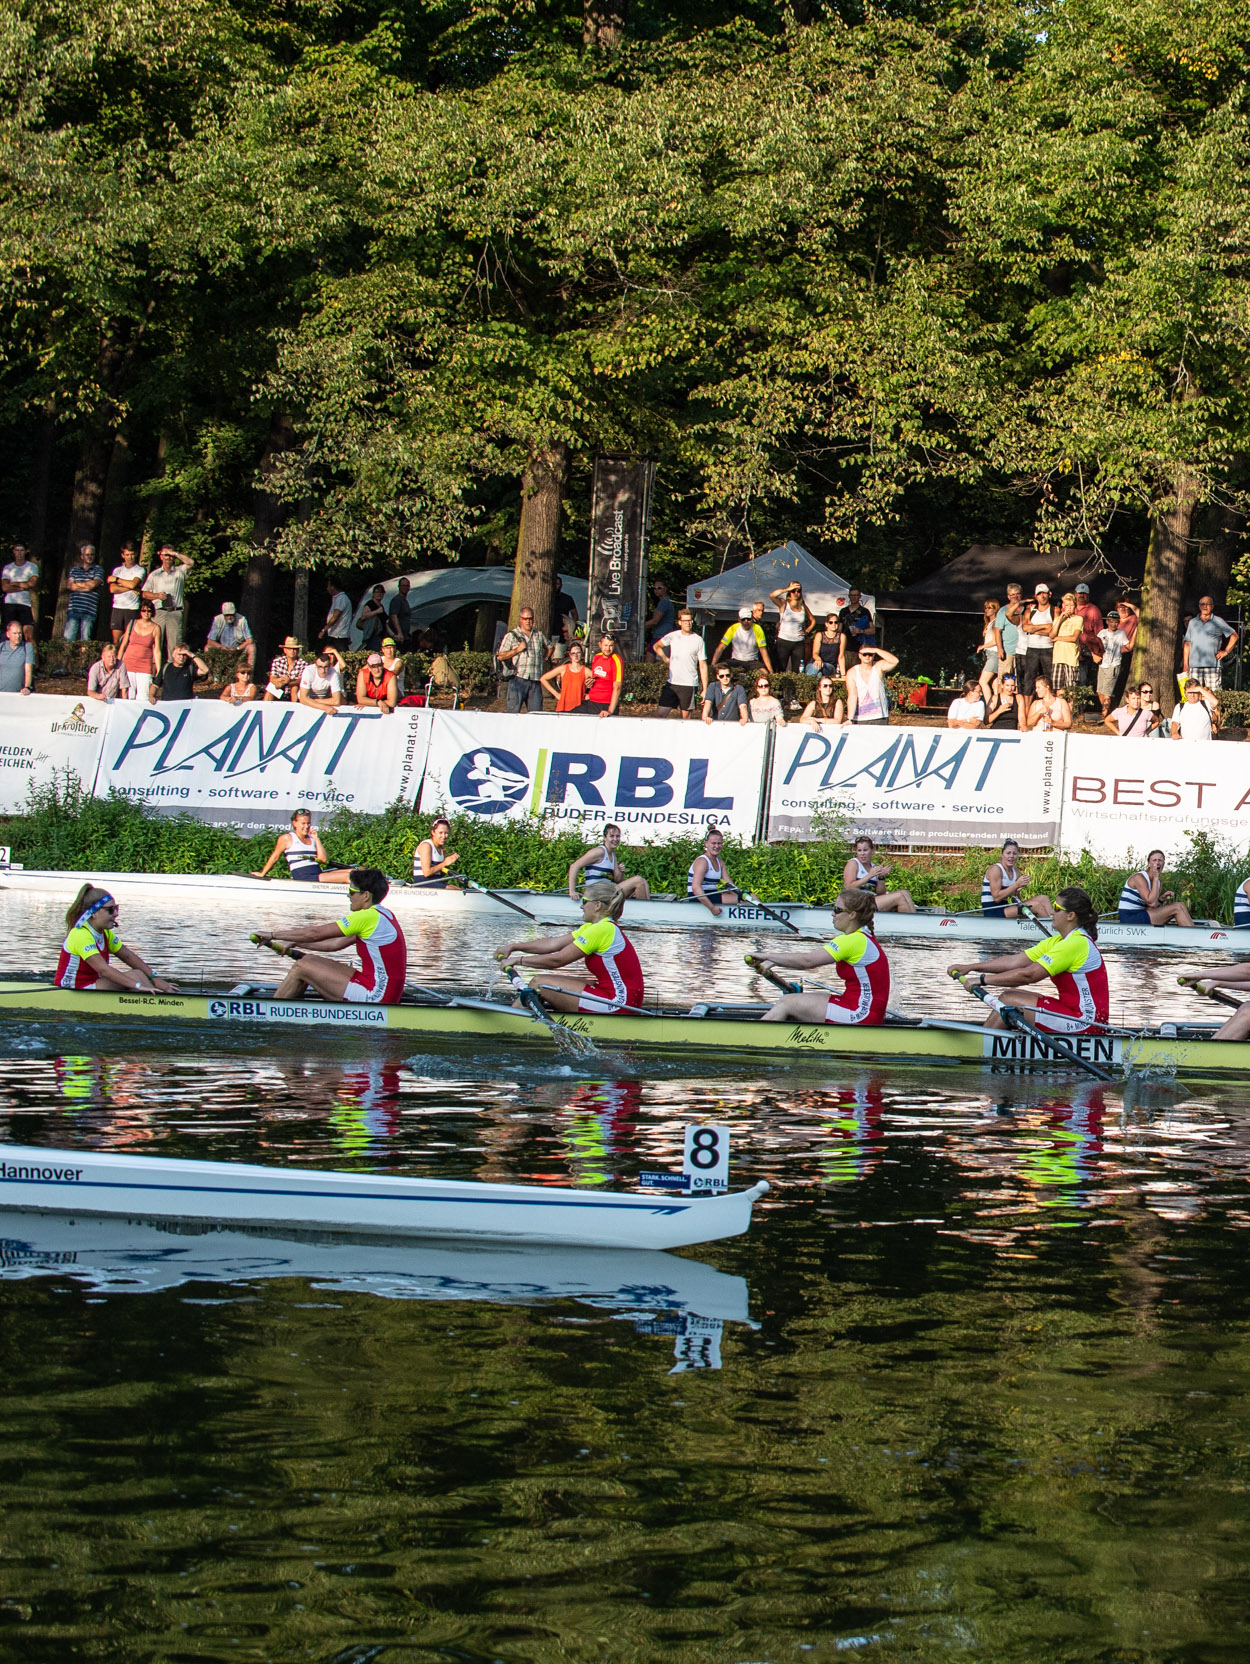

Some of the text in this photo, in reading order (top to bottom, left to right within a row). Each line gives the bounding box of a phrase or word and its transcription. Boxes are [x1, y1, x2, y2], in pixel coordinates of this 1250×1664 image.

[609, 509, 624, 595] Live Broadcast
[112, 708, 382, 778] PLANAT
[783, 732, 1021, 793] PLANAT
[545, 751, 734, 810] RBL
[1042, 740, 1054, 815] www.planat.de
[209, 785, 279, 799] software
[297, 788, 355, 803] service
[1071, 776, 1216, 808] BEST
[544, 807, 731, 826] RUDER-BUNDESLIGA
[872, 799, 934, 811] software
[952, 803, 1004, 814] service
[247, 821, 265, 831] den
[853, 827, 892, 836] Software
[895, 828, 906, 836] für
[909, 829, 925, 837] den
[928, 830, 998, 840] produzierenden
[1000, 831, 1049, 840] Mittelstand
[1126, 928, 1147, 938] SWK
[158, 998, 185, 1008] Minden
[229, 1001, 385, 1022] RBL RUDER-BUNDESLIGA
[785, 1024, 827, 1045] Melitta
[690, 1128, 720, 1169] 8
[705, 1178, 728, 1187] RBL
